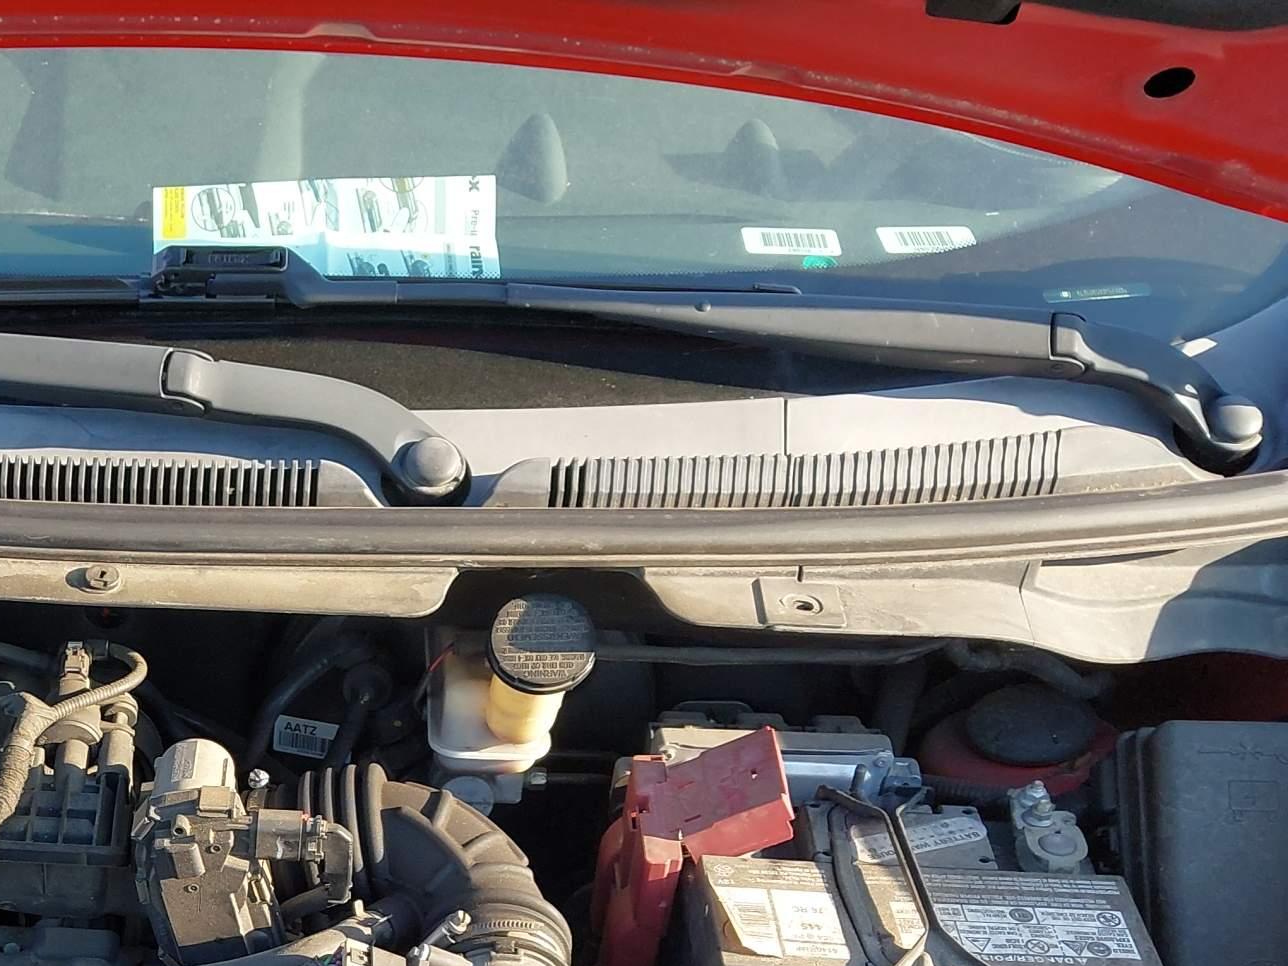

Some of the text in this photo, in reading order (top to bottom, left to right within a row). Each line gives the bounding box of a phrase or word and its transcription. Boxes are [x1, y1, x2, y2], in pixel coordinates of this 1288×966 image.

[523, 669, 567, 679] WARNING
[283, 721, 318, 736] AATZ
[932, 831, 981, 847] BATTERY
